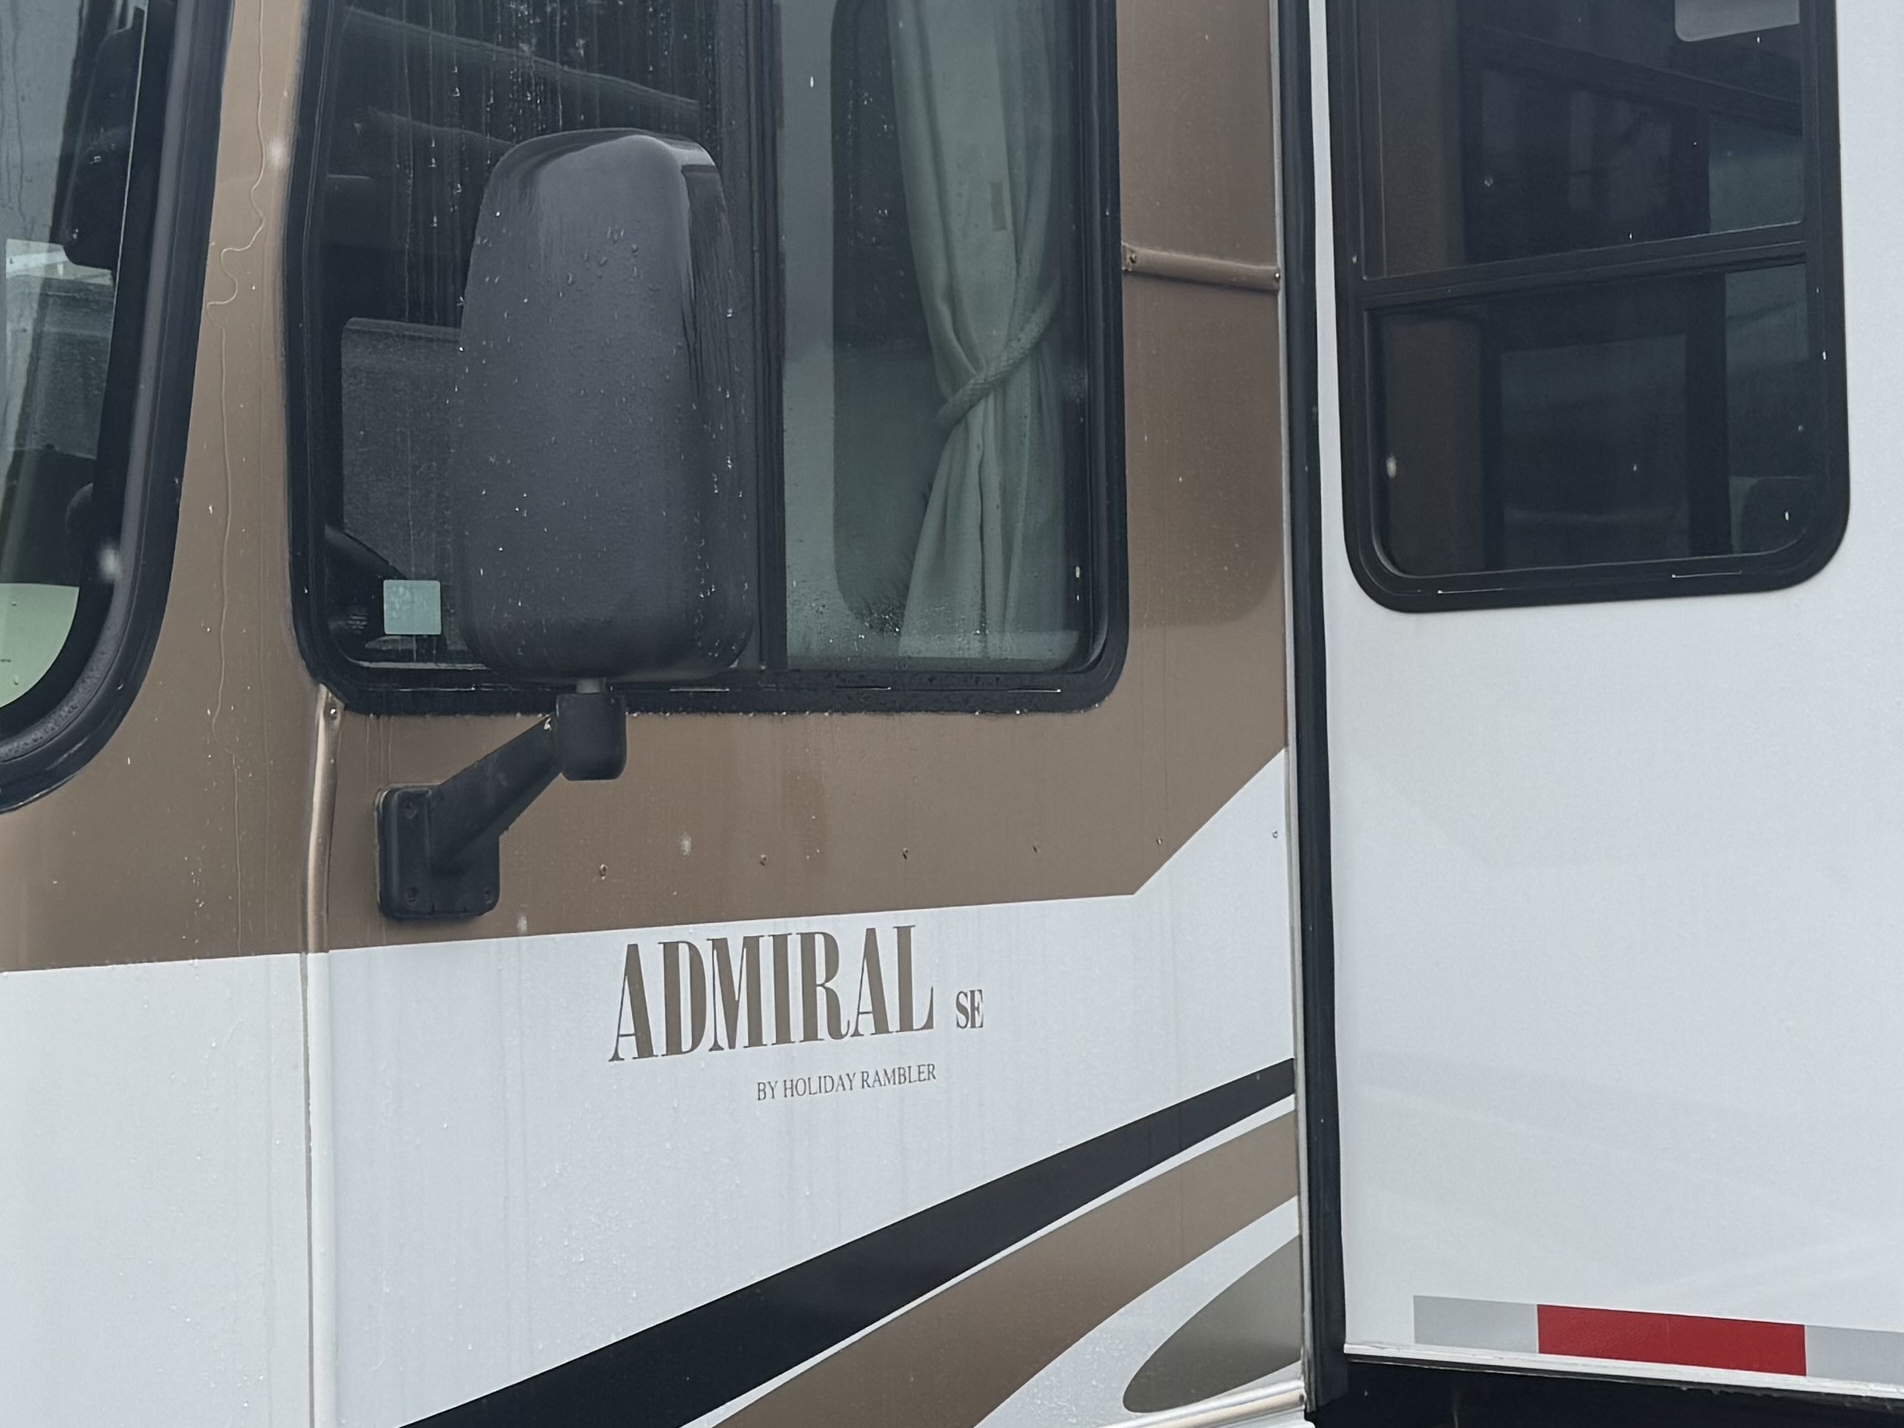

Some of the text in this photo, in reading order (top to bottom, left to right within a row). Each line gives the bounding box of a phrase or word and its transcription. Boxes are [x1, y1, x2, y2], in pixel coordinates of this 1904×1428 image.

[607, 924, 985, 1063] ADMIRAL SE
[756, 1062, 938, 1102] BY HOLIDAY RAMBLER
